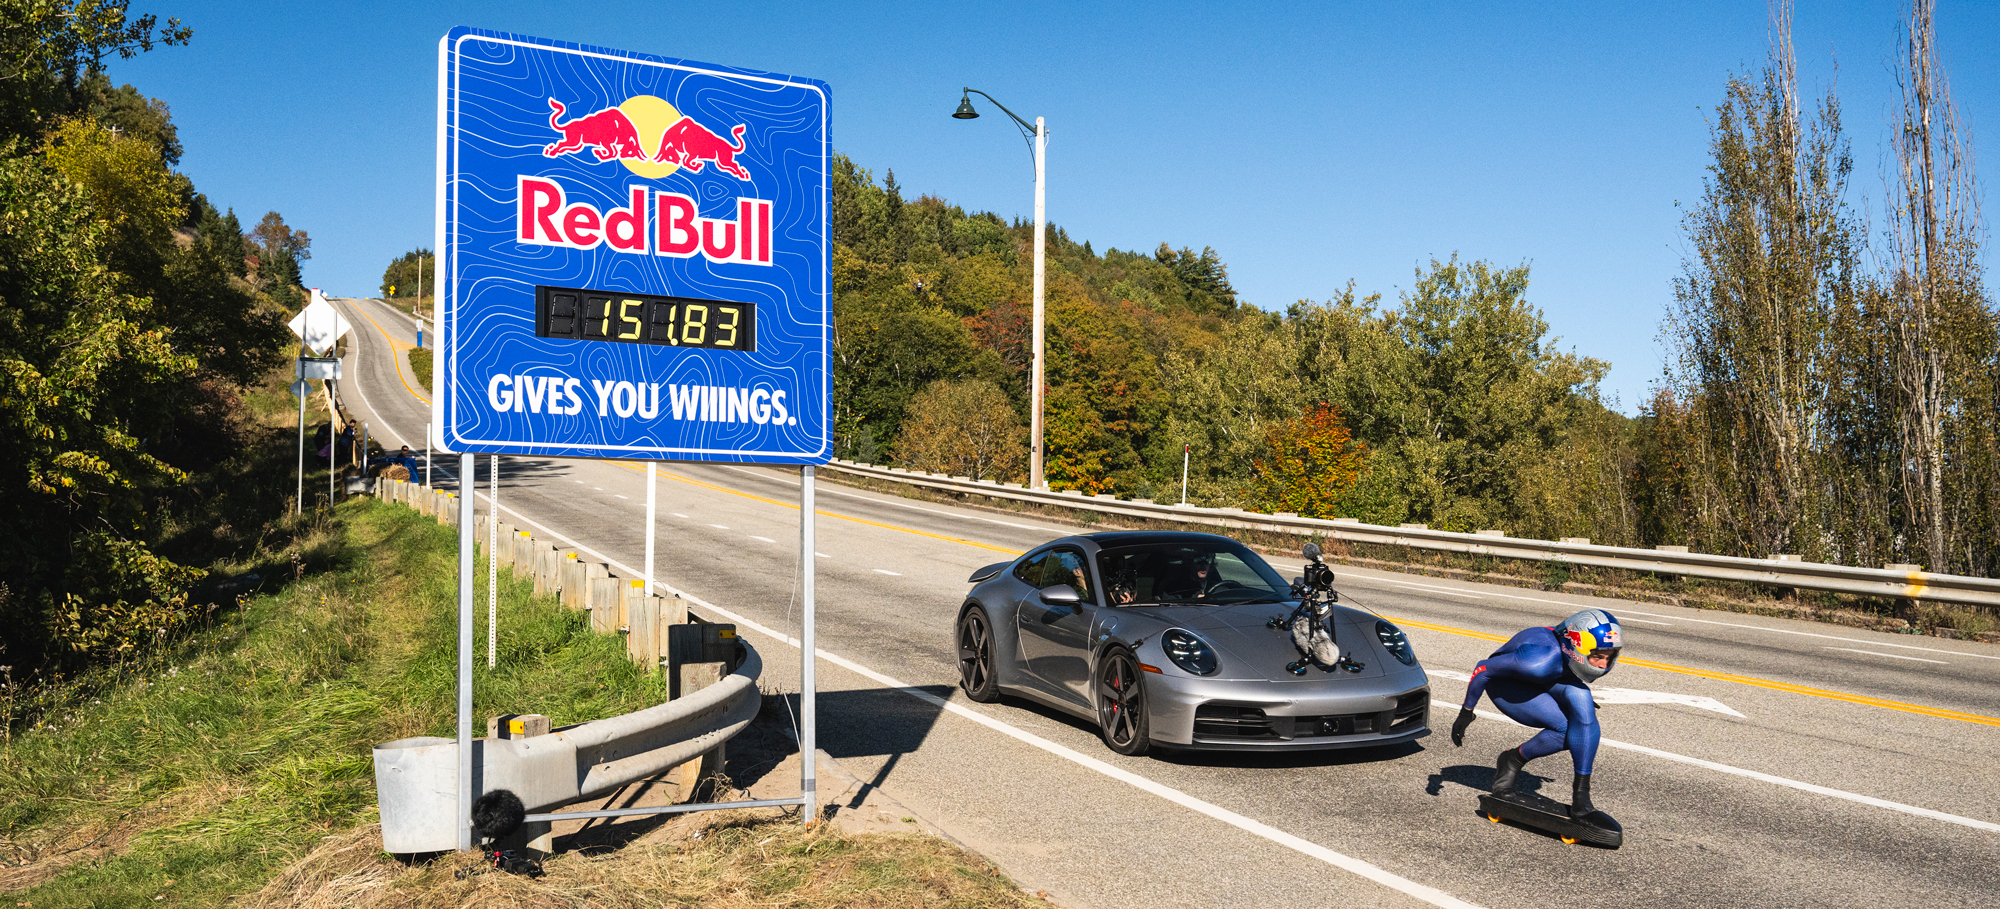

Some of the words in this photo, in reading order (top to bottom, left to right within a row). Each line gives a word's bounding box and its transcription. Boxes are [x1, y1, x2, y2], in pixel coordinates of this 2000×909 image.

[519, 177, 647, 254] Red
[656, 193, 771, 264] Bull
[487, 372, 583, 416] GIVES
[591, 378, 661, 420] YOU
[668, 382, 798, 427] WIIINGS.
